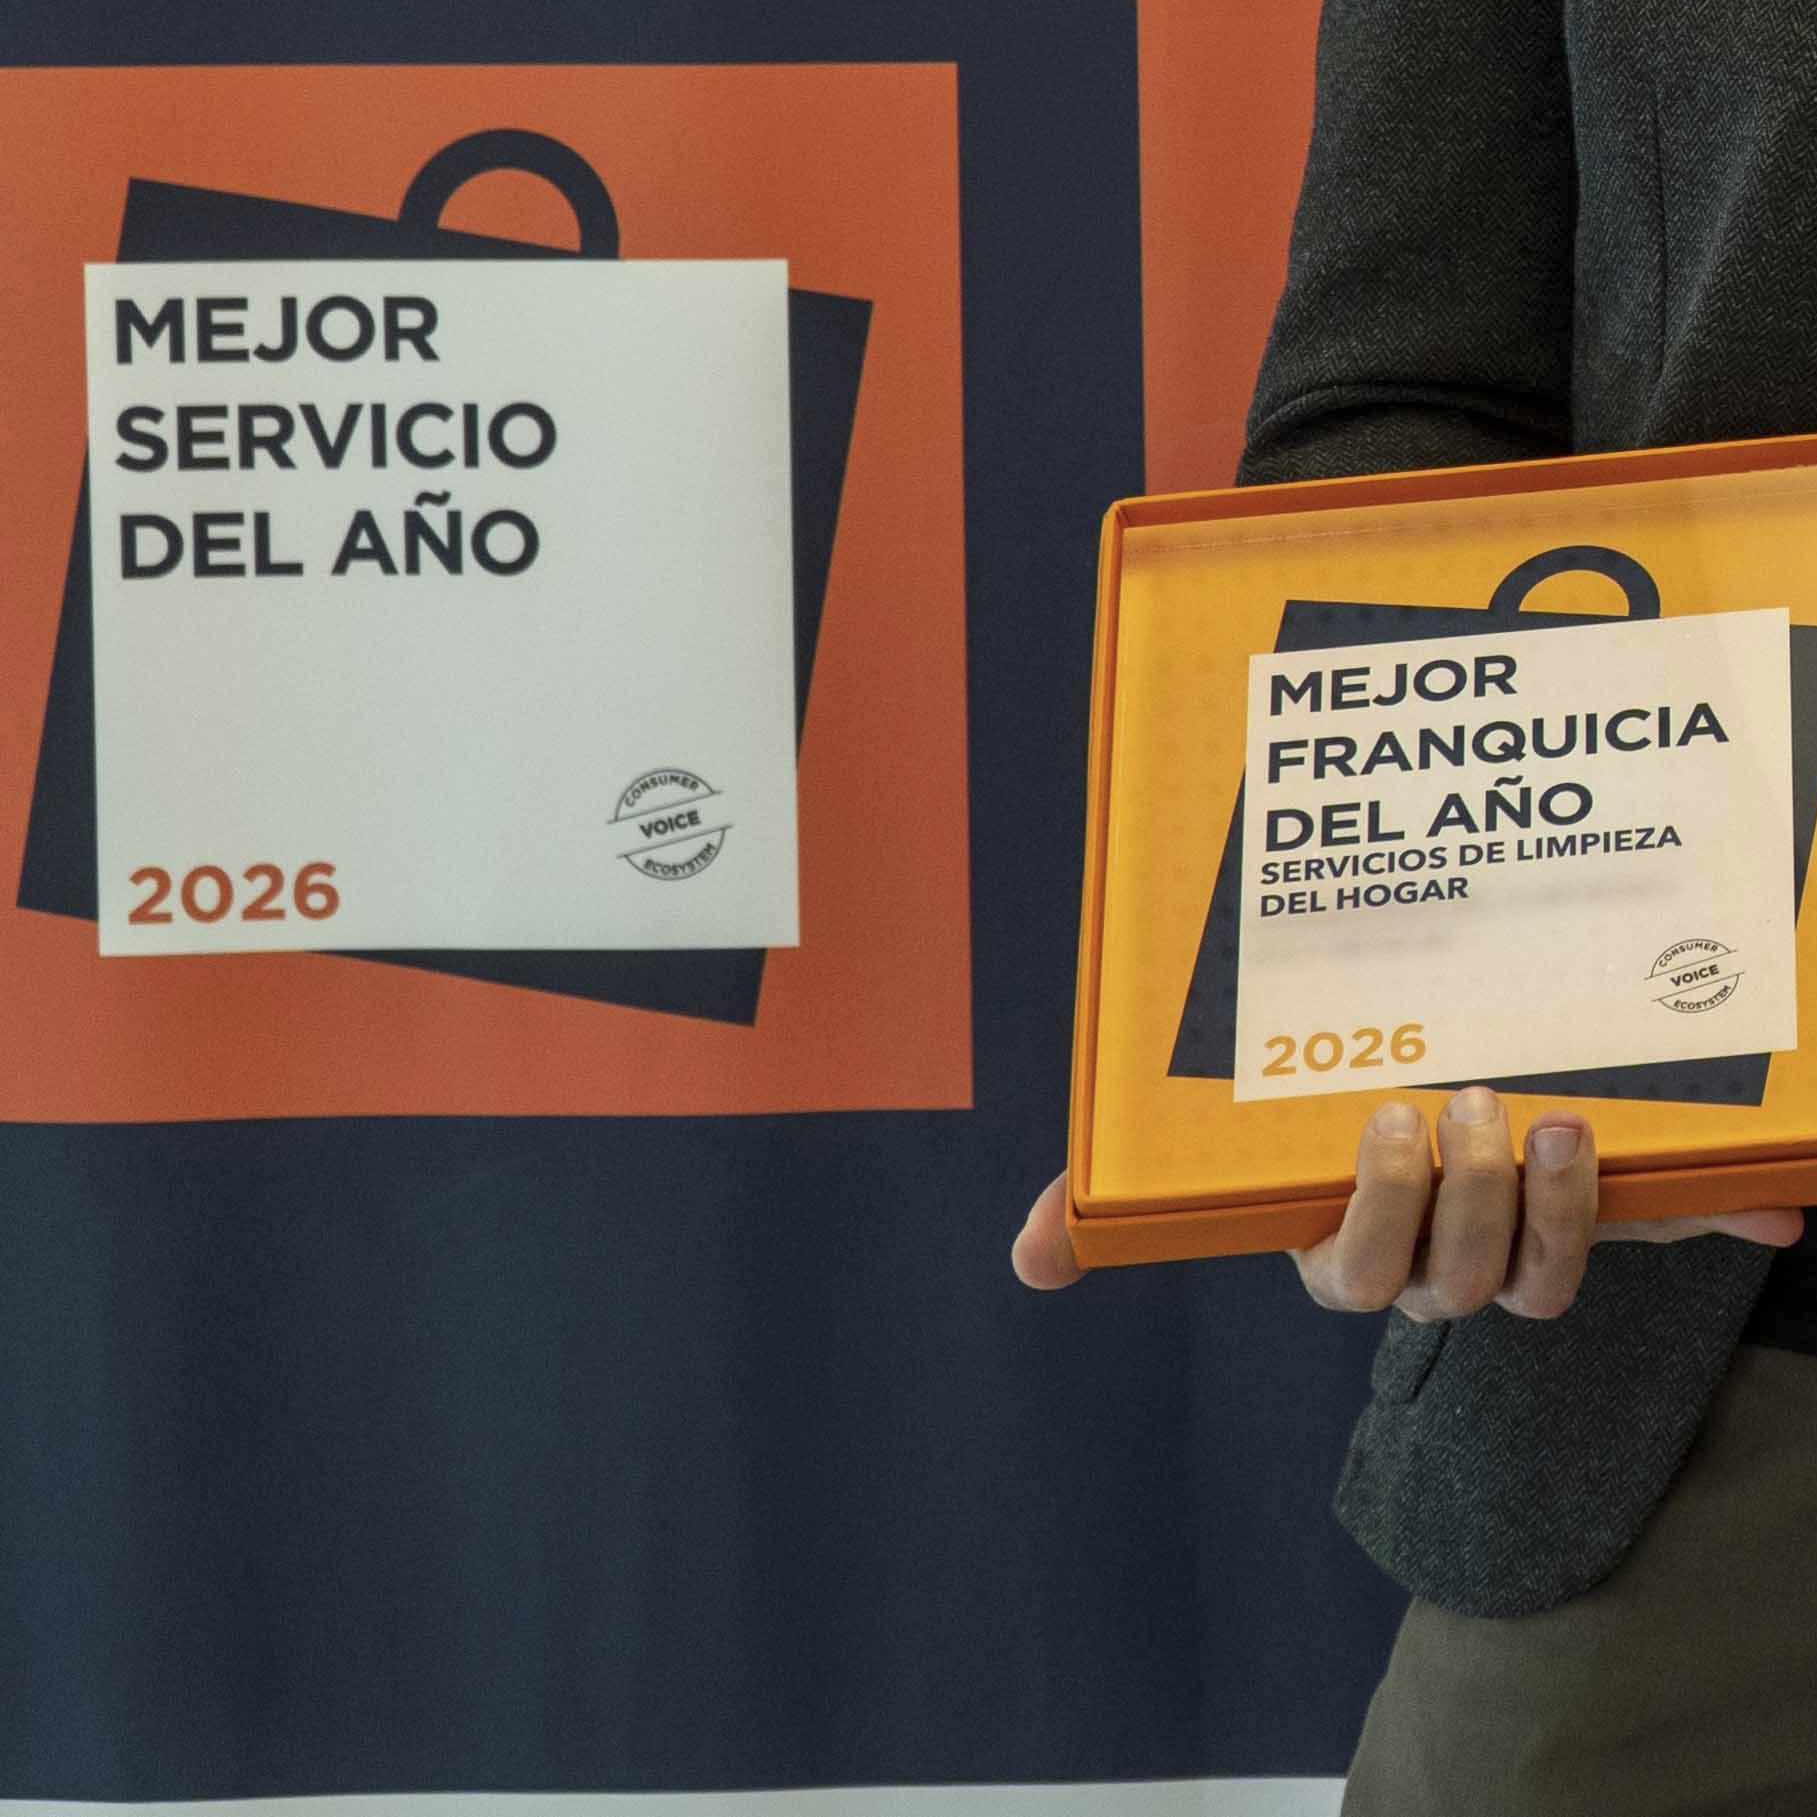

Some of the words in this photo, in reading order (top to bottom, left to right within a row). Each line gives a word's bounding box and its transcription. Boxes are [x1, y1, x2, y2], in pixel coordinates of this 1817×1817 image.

[116, 296, 438, 364] MEJOR
[116, 402, 556, 472] SERVICIO
[120, 512, 303, 579] DEL
[332, 491, 539, 576] AÑO
[1270, 655, 1517, 716] MEJOR
[1268, 703, 1729, 783] FRANQUICIA
[639, 809, 702, 839] VOICE
[1266, 801, 1404, 852] DEL
[1426, 776, 1592, 837] AÑO
[1261, 847, 1447, 884] SERVICIOS
[1459, 842, 1505, 866] DE
[1517, 826, 1682, 861] LIMPIEZA
[128, 862, 339, 924] 2026
[1261, 891, 1326, 917] DEL
[1337, 878, 1468, 910] HOGAR
[1659, 942, 1718, 967] CONSUMER
[1670, 964, 1719, 986] VOICE
[1262, 1024, 1425, 1076] 2026
